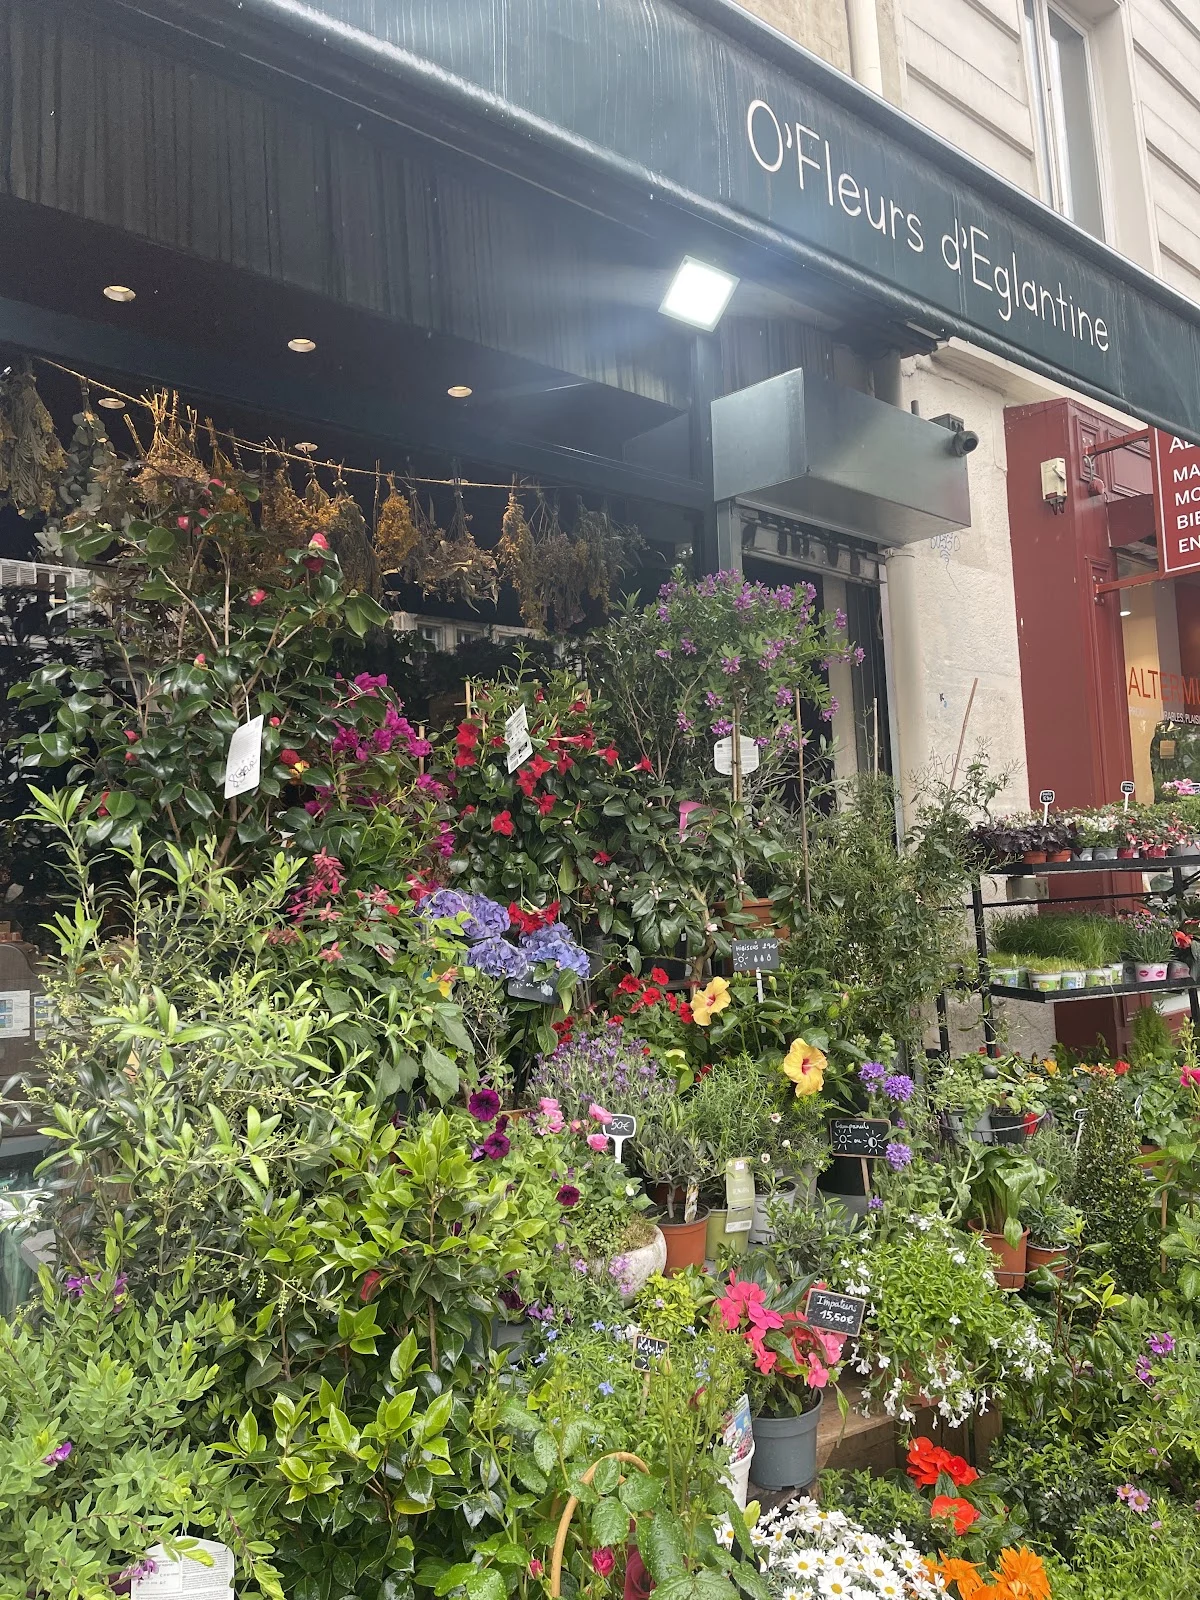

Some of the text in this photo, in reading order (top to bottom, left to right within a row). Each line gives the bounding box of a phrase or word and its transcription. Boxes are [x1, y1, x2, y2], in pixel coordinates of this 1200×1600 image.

[746, 99, 1109, 352] O'Fleurs d'Eglantine
[819, 1309, 855, 1324] 15,50€
